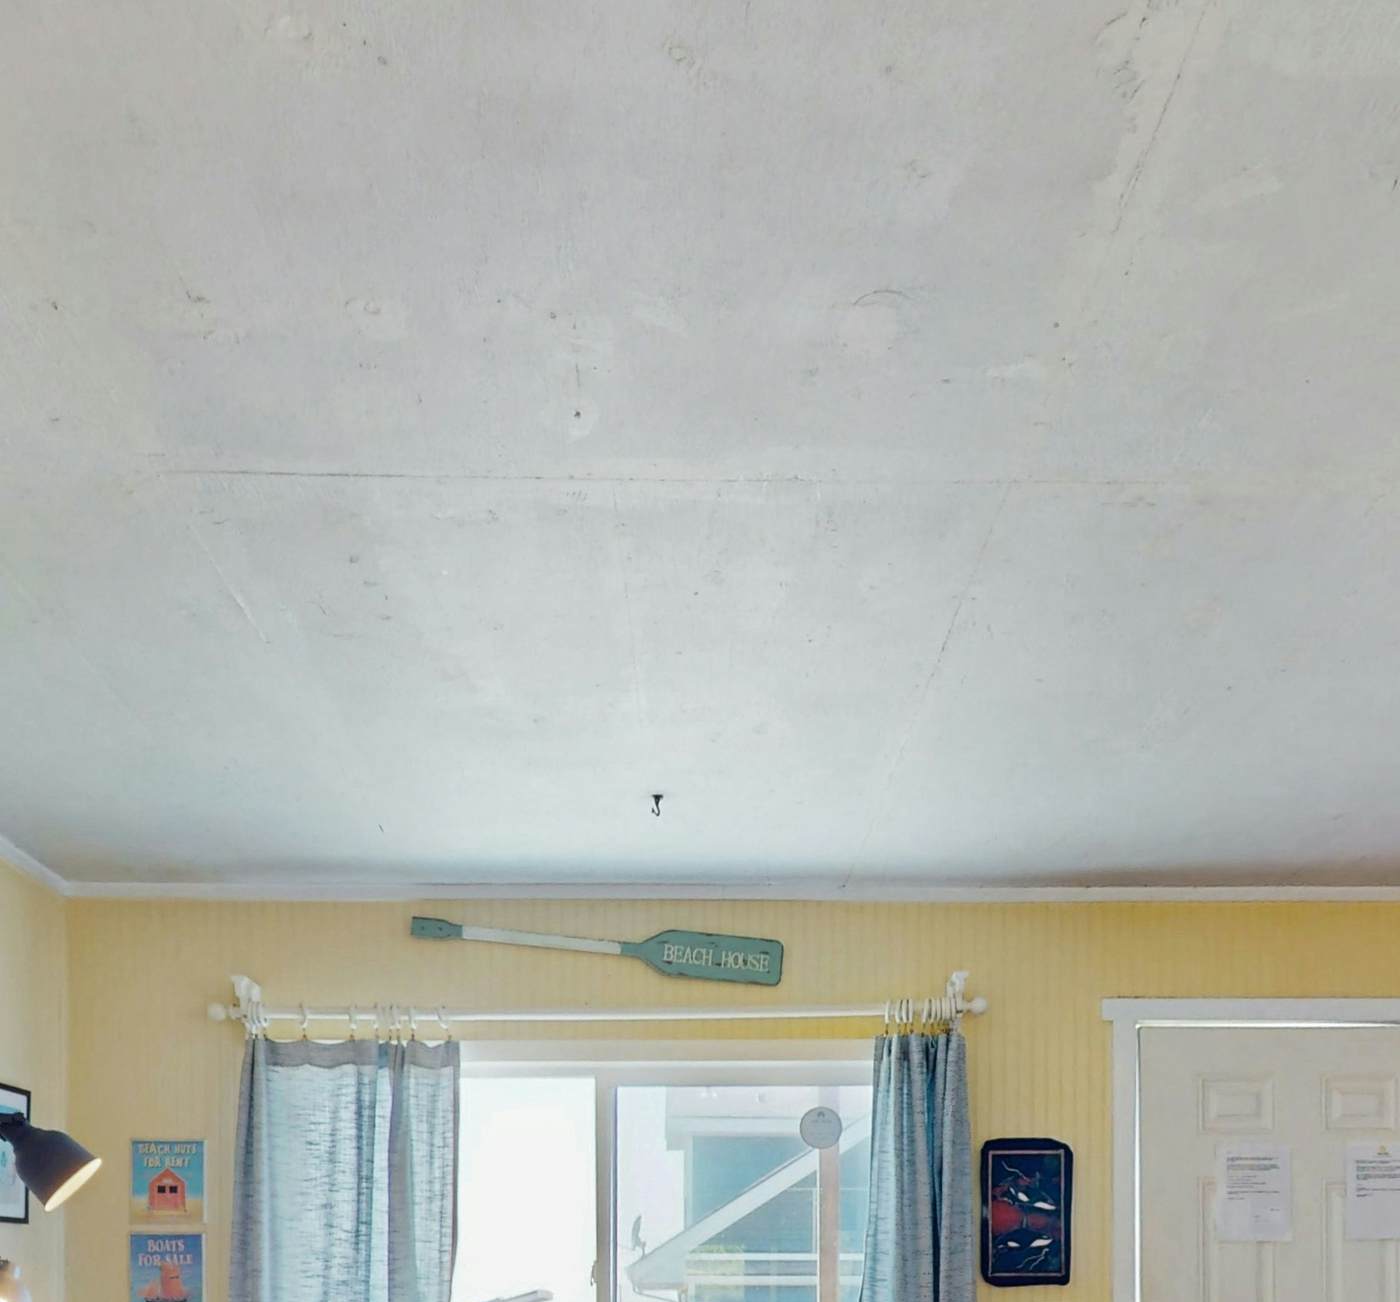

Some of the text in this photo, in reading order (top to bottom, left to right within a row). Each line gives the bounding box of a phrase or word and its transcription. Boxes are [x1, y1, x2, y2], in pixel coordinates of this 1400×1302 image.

[663, 943, 770, 972] BEACH HOUSE
[139, 1143, 170, 1154] BEACH
[143, 1156, 190, 1168] FOR RENT
[147, 1239, 185, 1252] BOATS
[138, 1253, 193, 1266] FOR SALE
